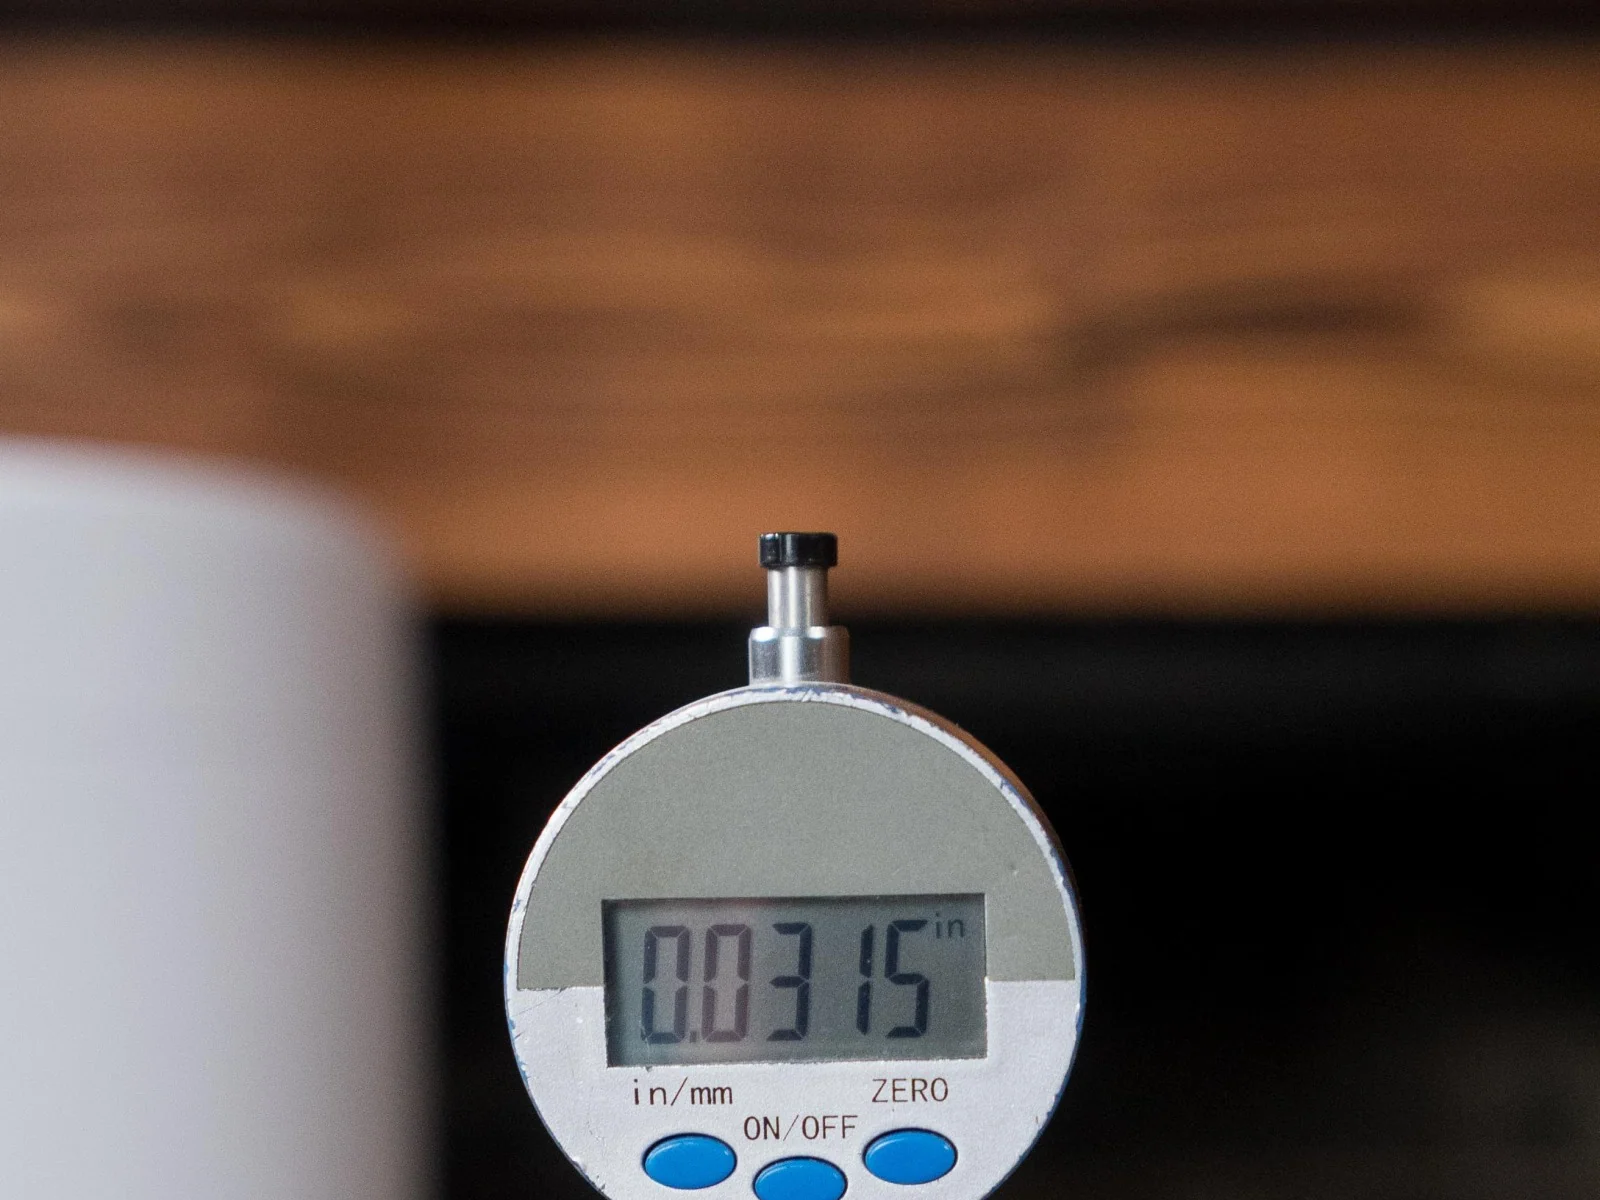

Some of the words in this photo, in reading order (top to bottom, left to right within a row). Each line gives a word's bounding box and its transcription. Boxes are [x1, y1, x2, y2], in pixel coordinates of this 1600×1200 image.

[641, 920, 931, 1044] 0.0315
[934, 912, 966, 939] in
[633, 1077, 734, 1106] in/mm
[872, 1078, 949, 1103] ZERO
[743, 1114, 859, 1141] ON/OFF
